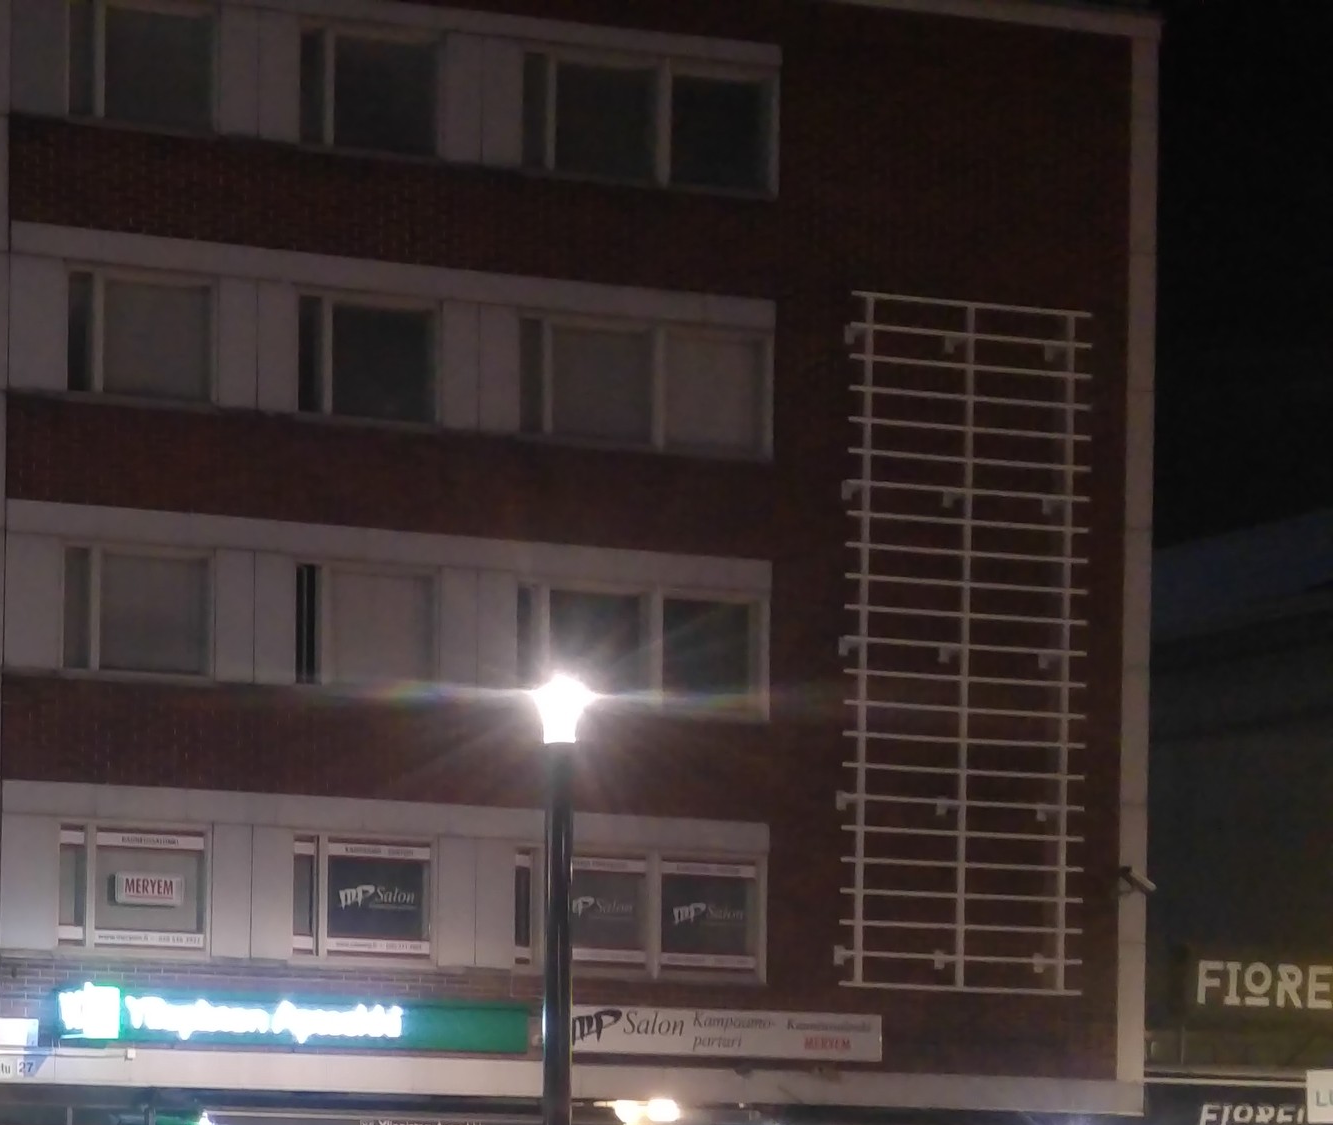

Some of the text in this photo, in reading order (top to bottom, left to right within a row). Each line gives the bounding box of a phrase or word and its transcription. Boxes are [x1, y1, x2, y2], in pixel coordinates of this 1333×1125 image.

[124, 878, 174, 895] MERYEM
[376, 885, 415, 904] Salon
[1197, 960, 1333, 1009] FIORE
[623, 1011, 685, 1038] Salon
[18, 1062, 34, 1074] 27
